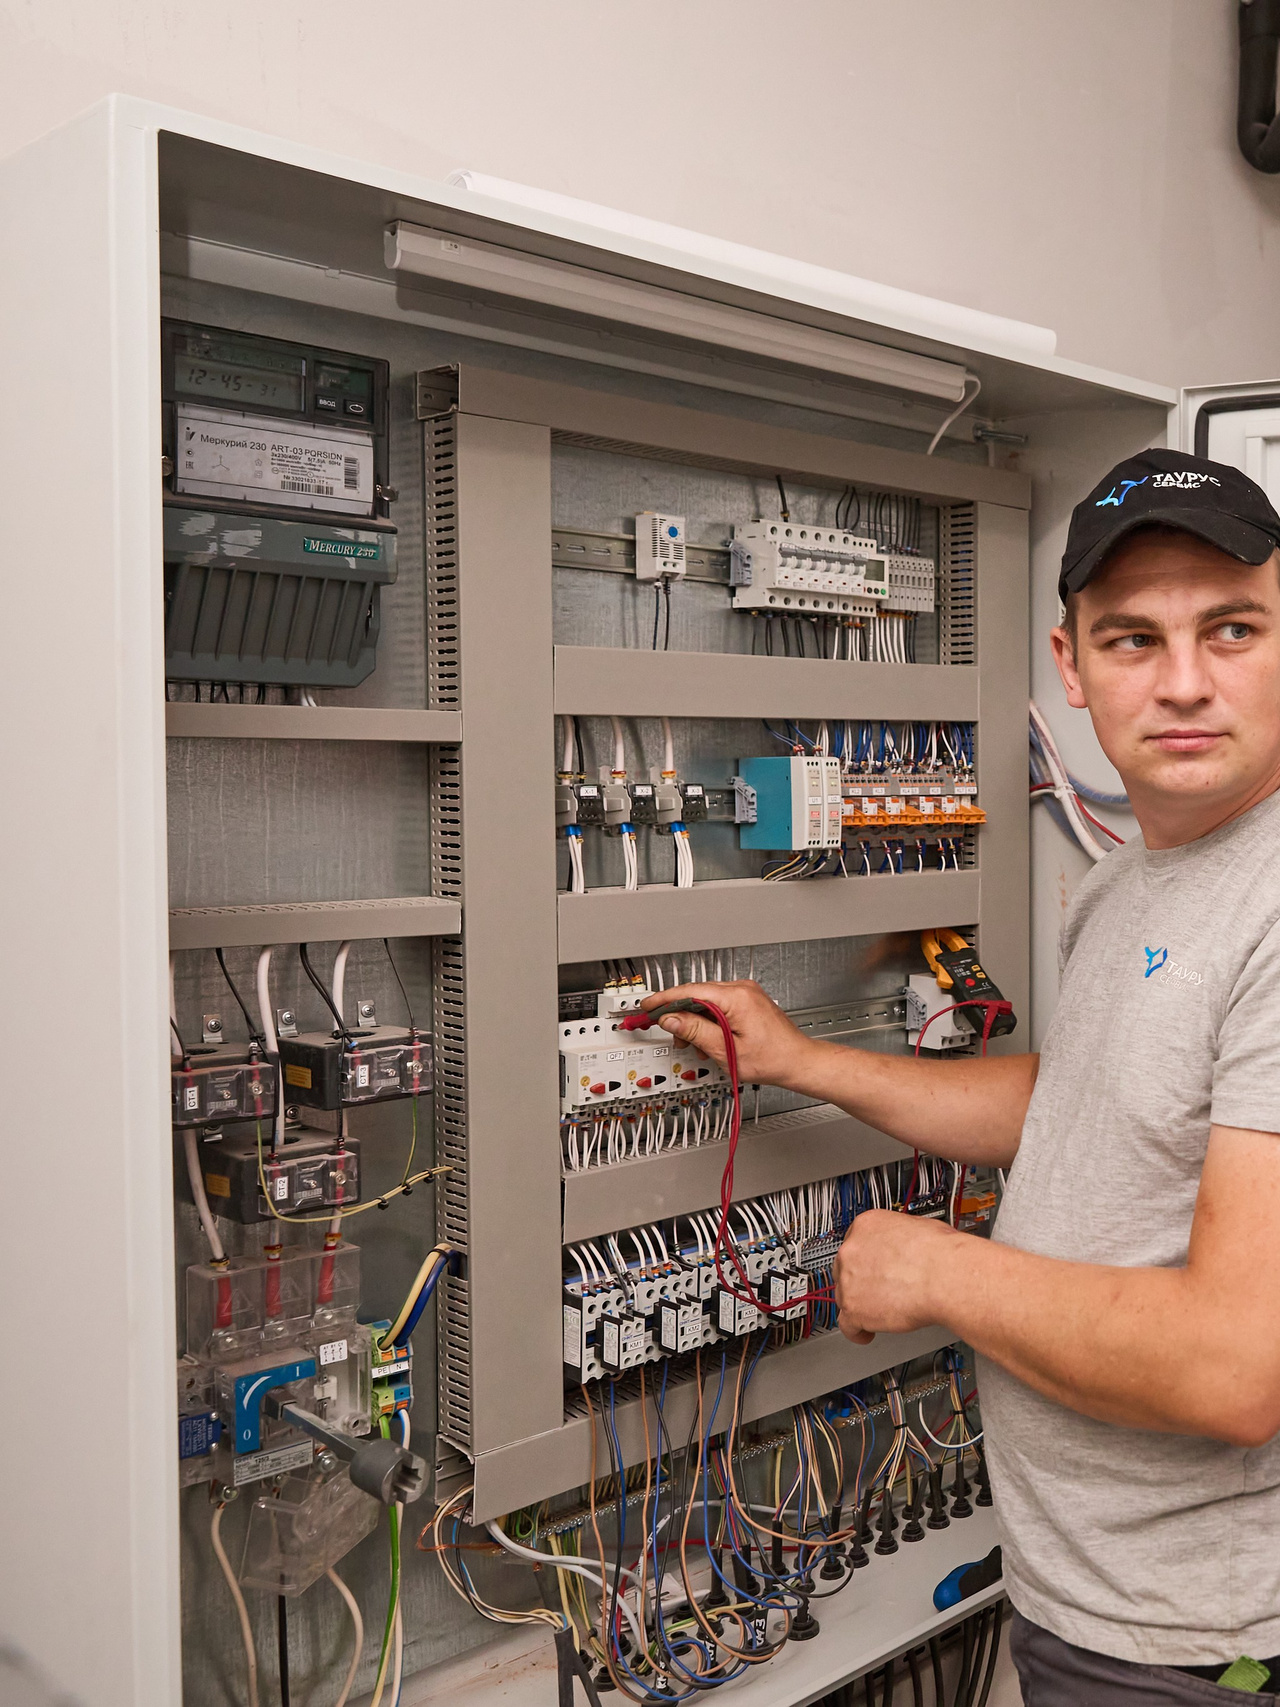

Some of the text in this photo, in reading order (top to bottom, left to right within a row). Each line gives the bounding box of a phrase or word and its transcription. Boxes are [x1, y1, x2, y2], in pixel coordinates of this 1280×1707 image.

[200, 434, 248, 451] Меркурий
[250, 441, 267, 451] 230
[271, 444, 303, 456] ART-03
[1152, 471, 1222, 487] ТАУРУС
[309, 540, 376, 557] MERCURY 230
[609, 1053, 622, 1061] QF7
[188, 1089, 196, 1108] CT-1
[687, 1325, 700, 1333] KM2
[629, 1341, 642, 1349] KM1
